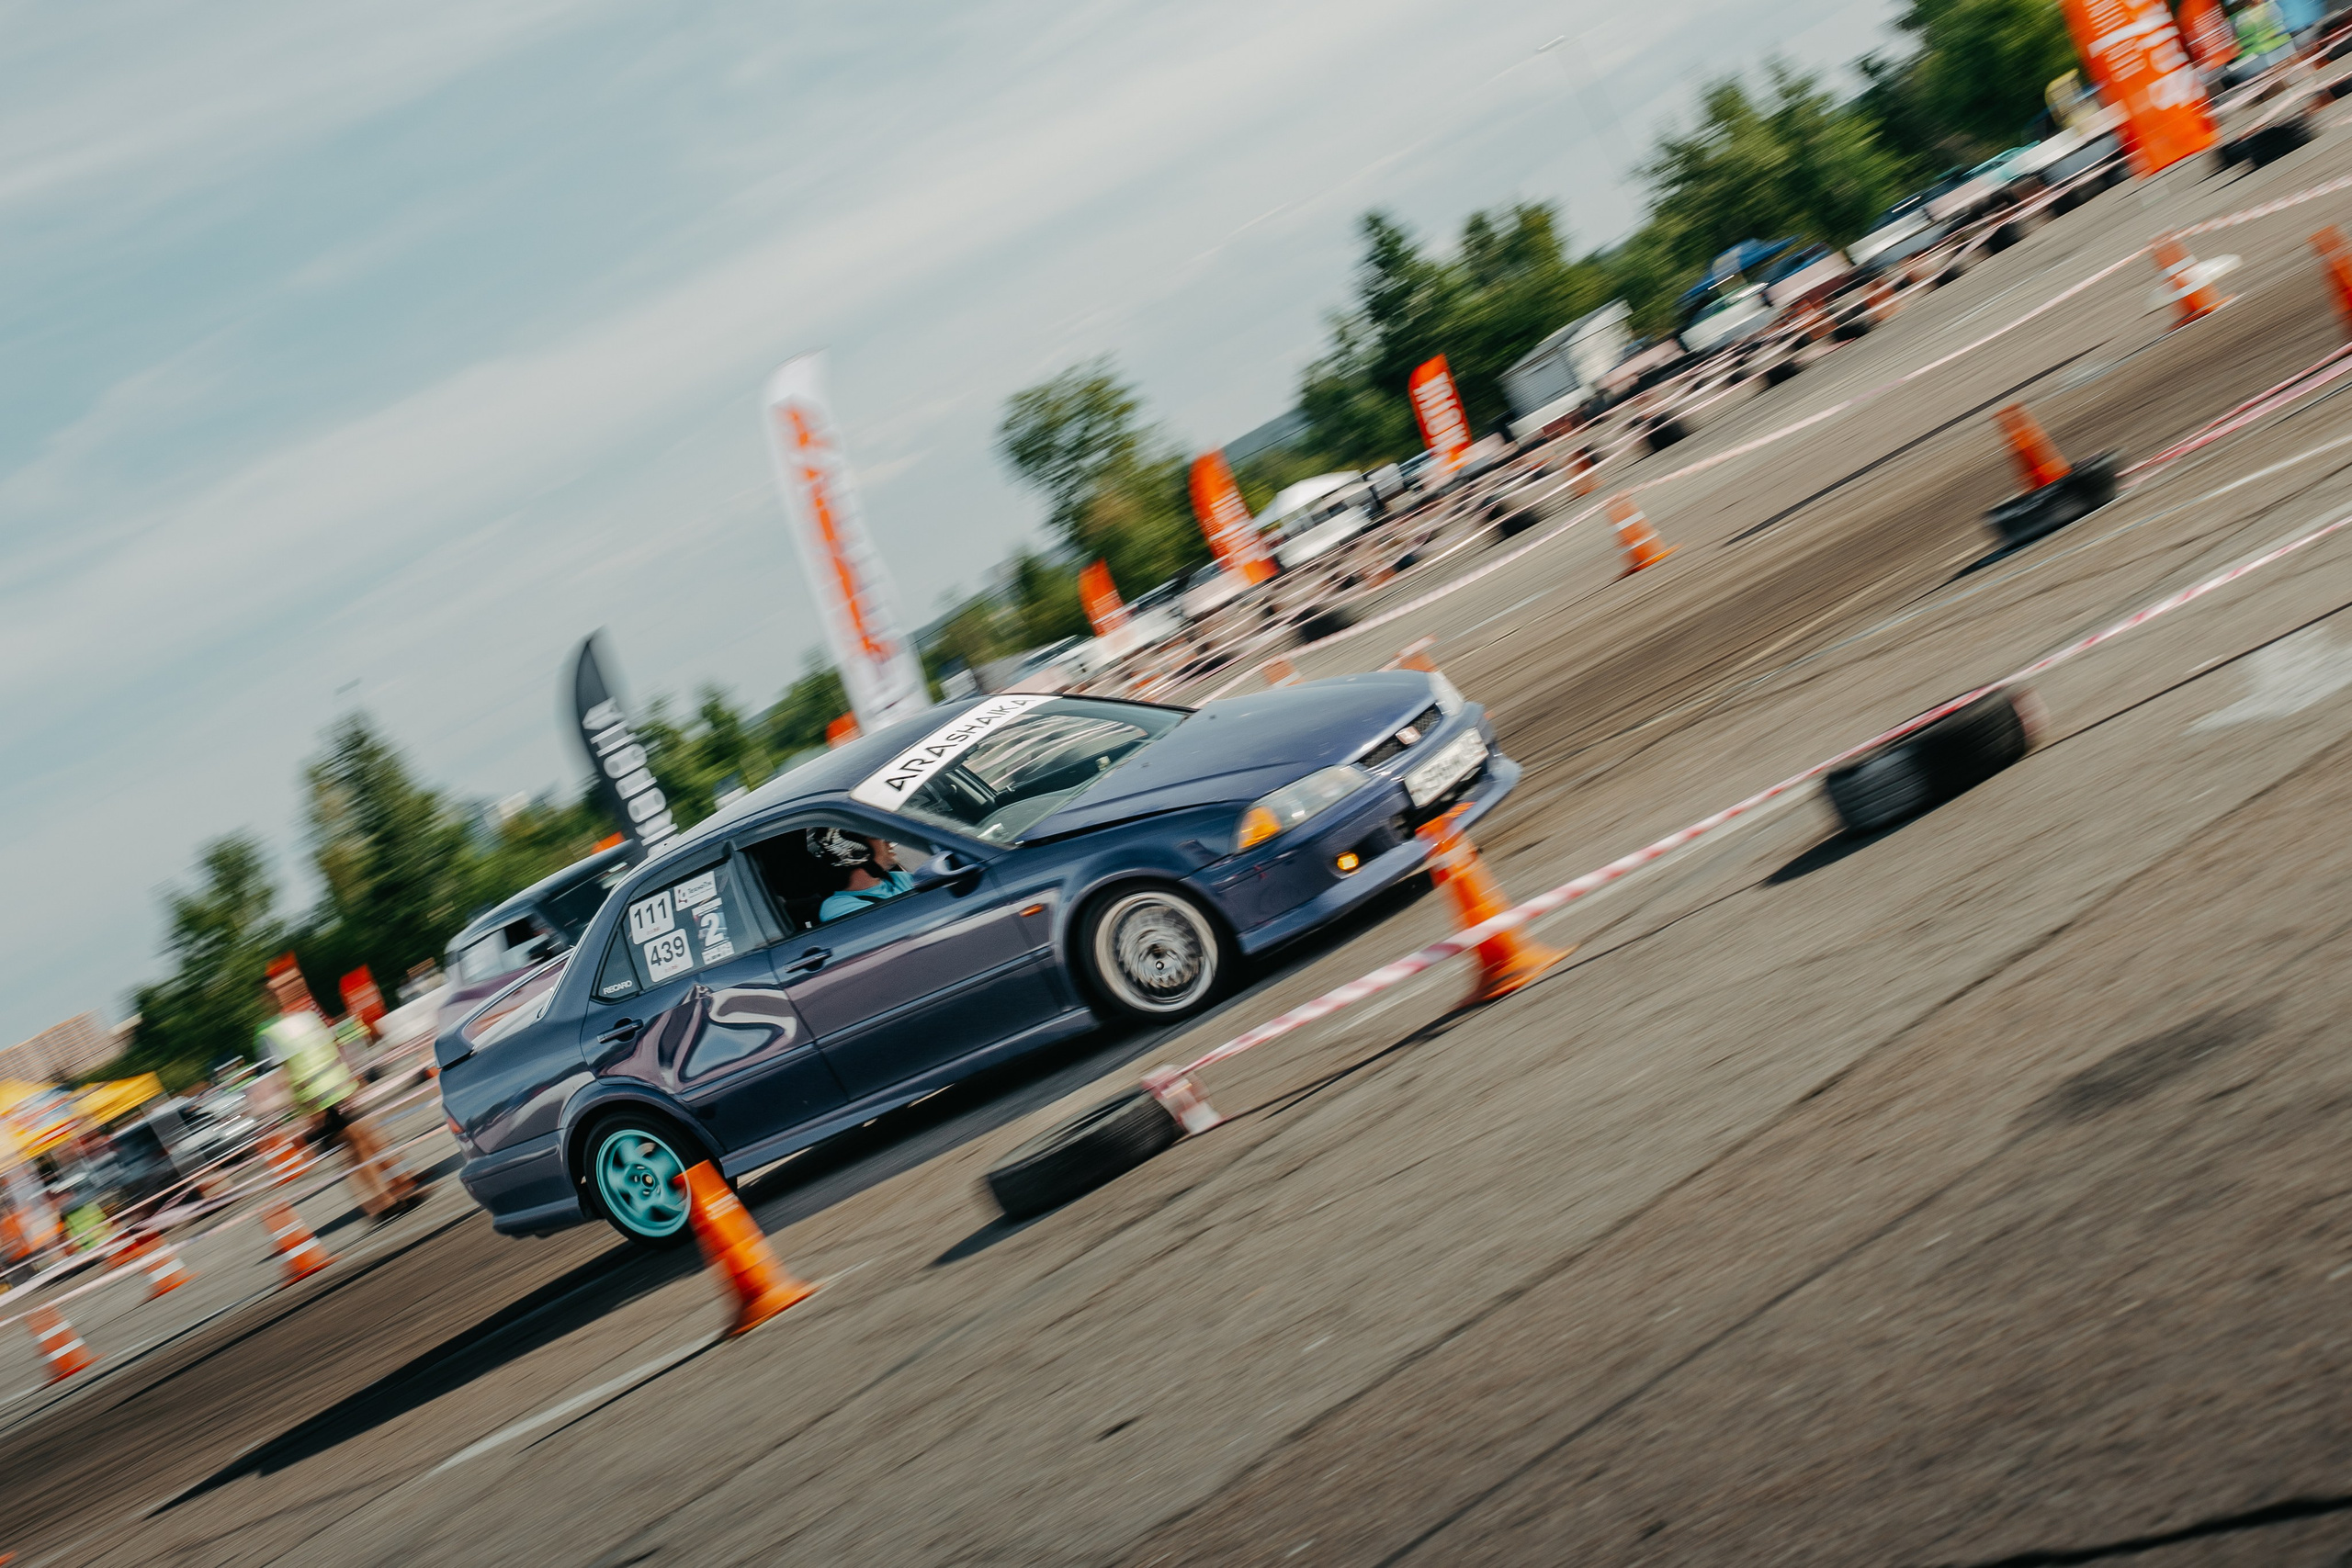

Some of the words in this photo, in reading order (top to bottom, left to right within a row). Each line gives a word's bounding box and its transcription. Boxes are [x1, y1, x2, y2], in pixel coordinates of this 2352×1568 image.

[885, 699, 1036, 792] ARASHAIKA
[634, 898, 668, 930] 111
[701, 912, 724, 947] 2
[650, 935, 685, 966] 439
[603, 979, 633, 995] RECARO
